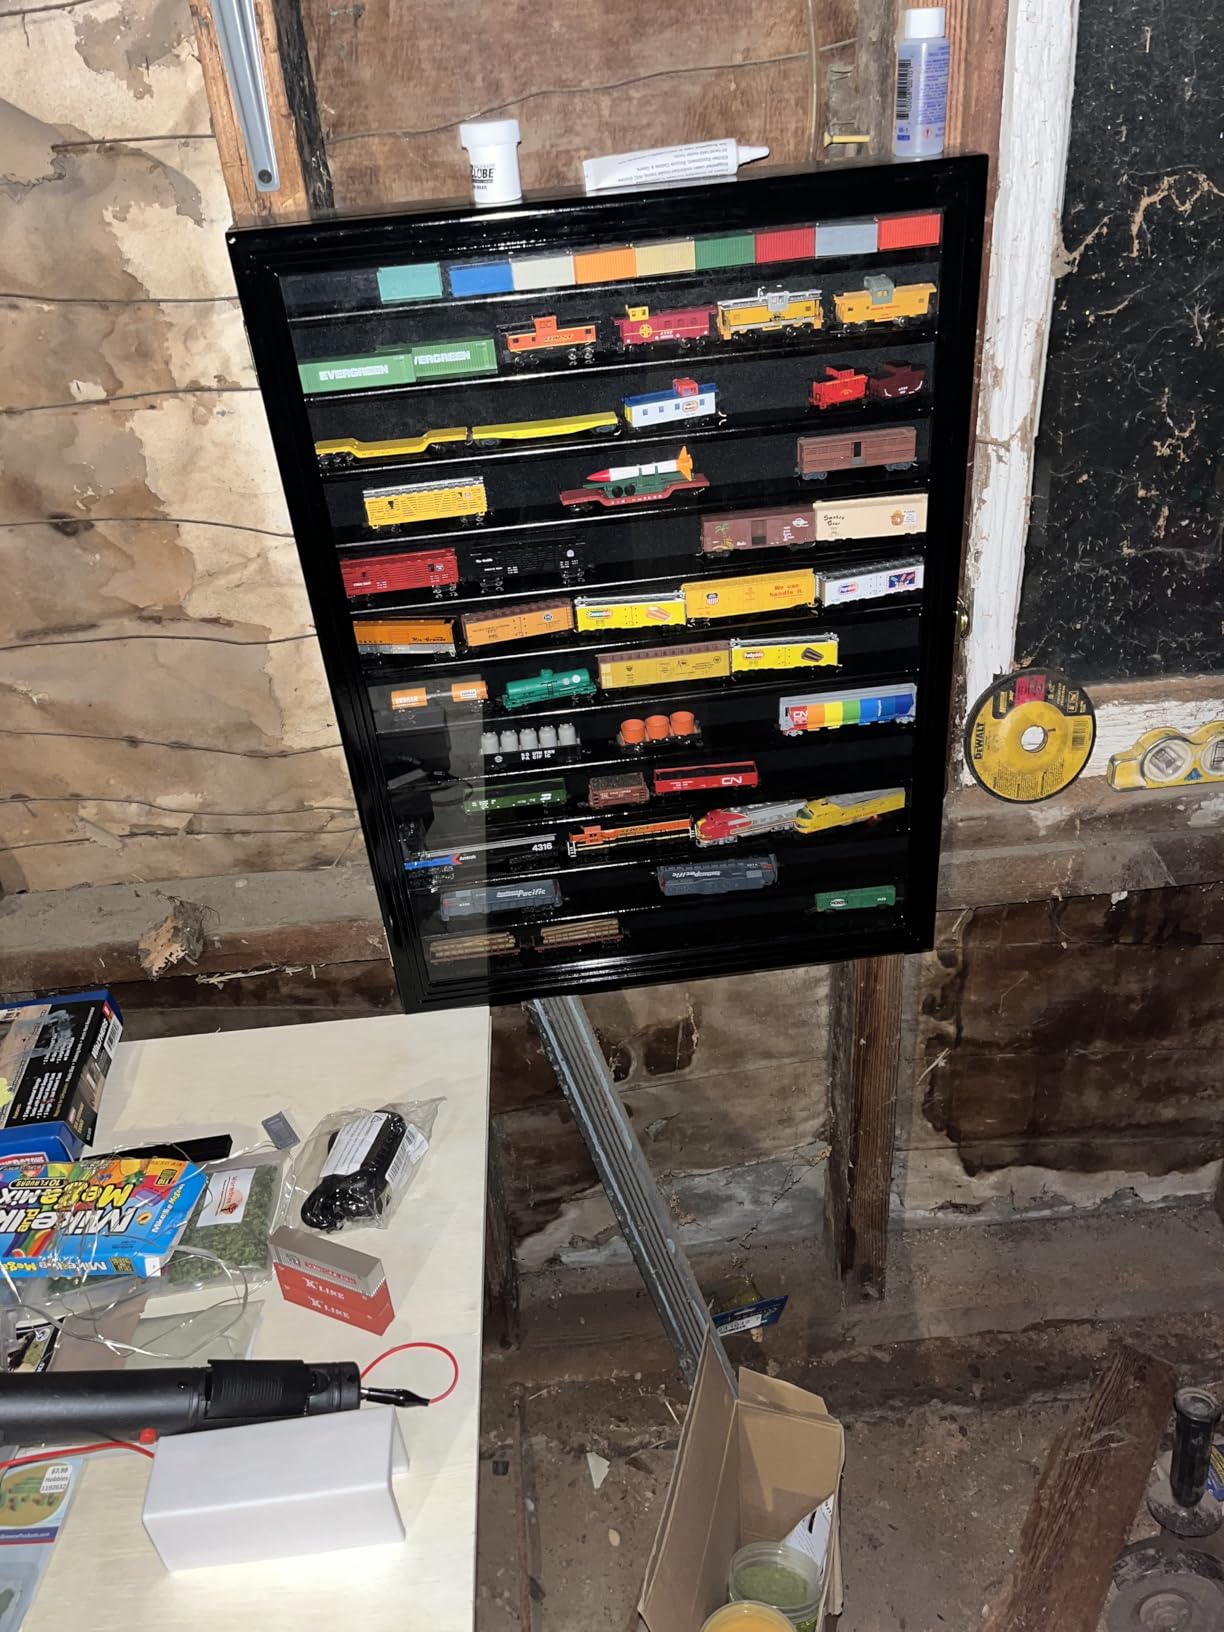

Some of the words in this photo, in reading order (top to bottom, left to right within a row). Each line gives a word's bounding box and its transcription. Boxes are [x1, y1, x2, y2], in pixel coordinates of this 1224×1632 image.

[414, 350, 471, 366] ERGREEN
[319, 364, 389, 381] EVERGREEN
[532, 842, 552, 852] 4316
[517, 887, 546, 898] Pacific
[15, 1180, 49, 1188] FLAVORS
[49, 1179, 62, 1188] 10
[33, 1207, 136, 1236] Mike
